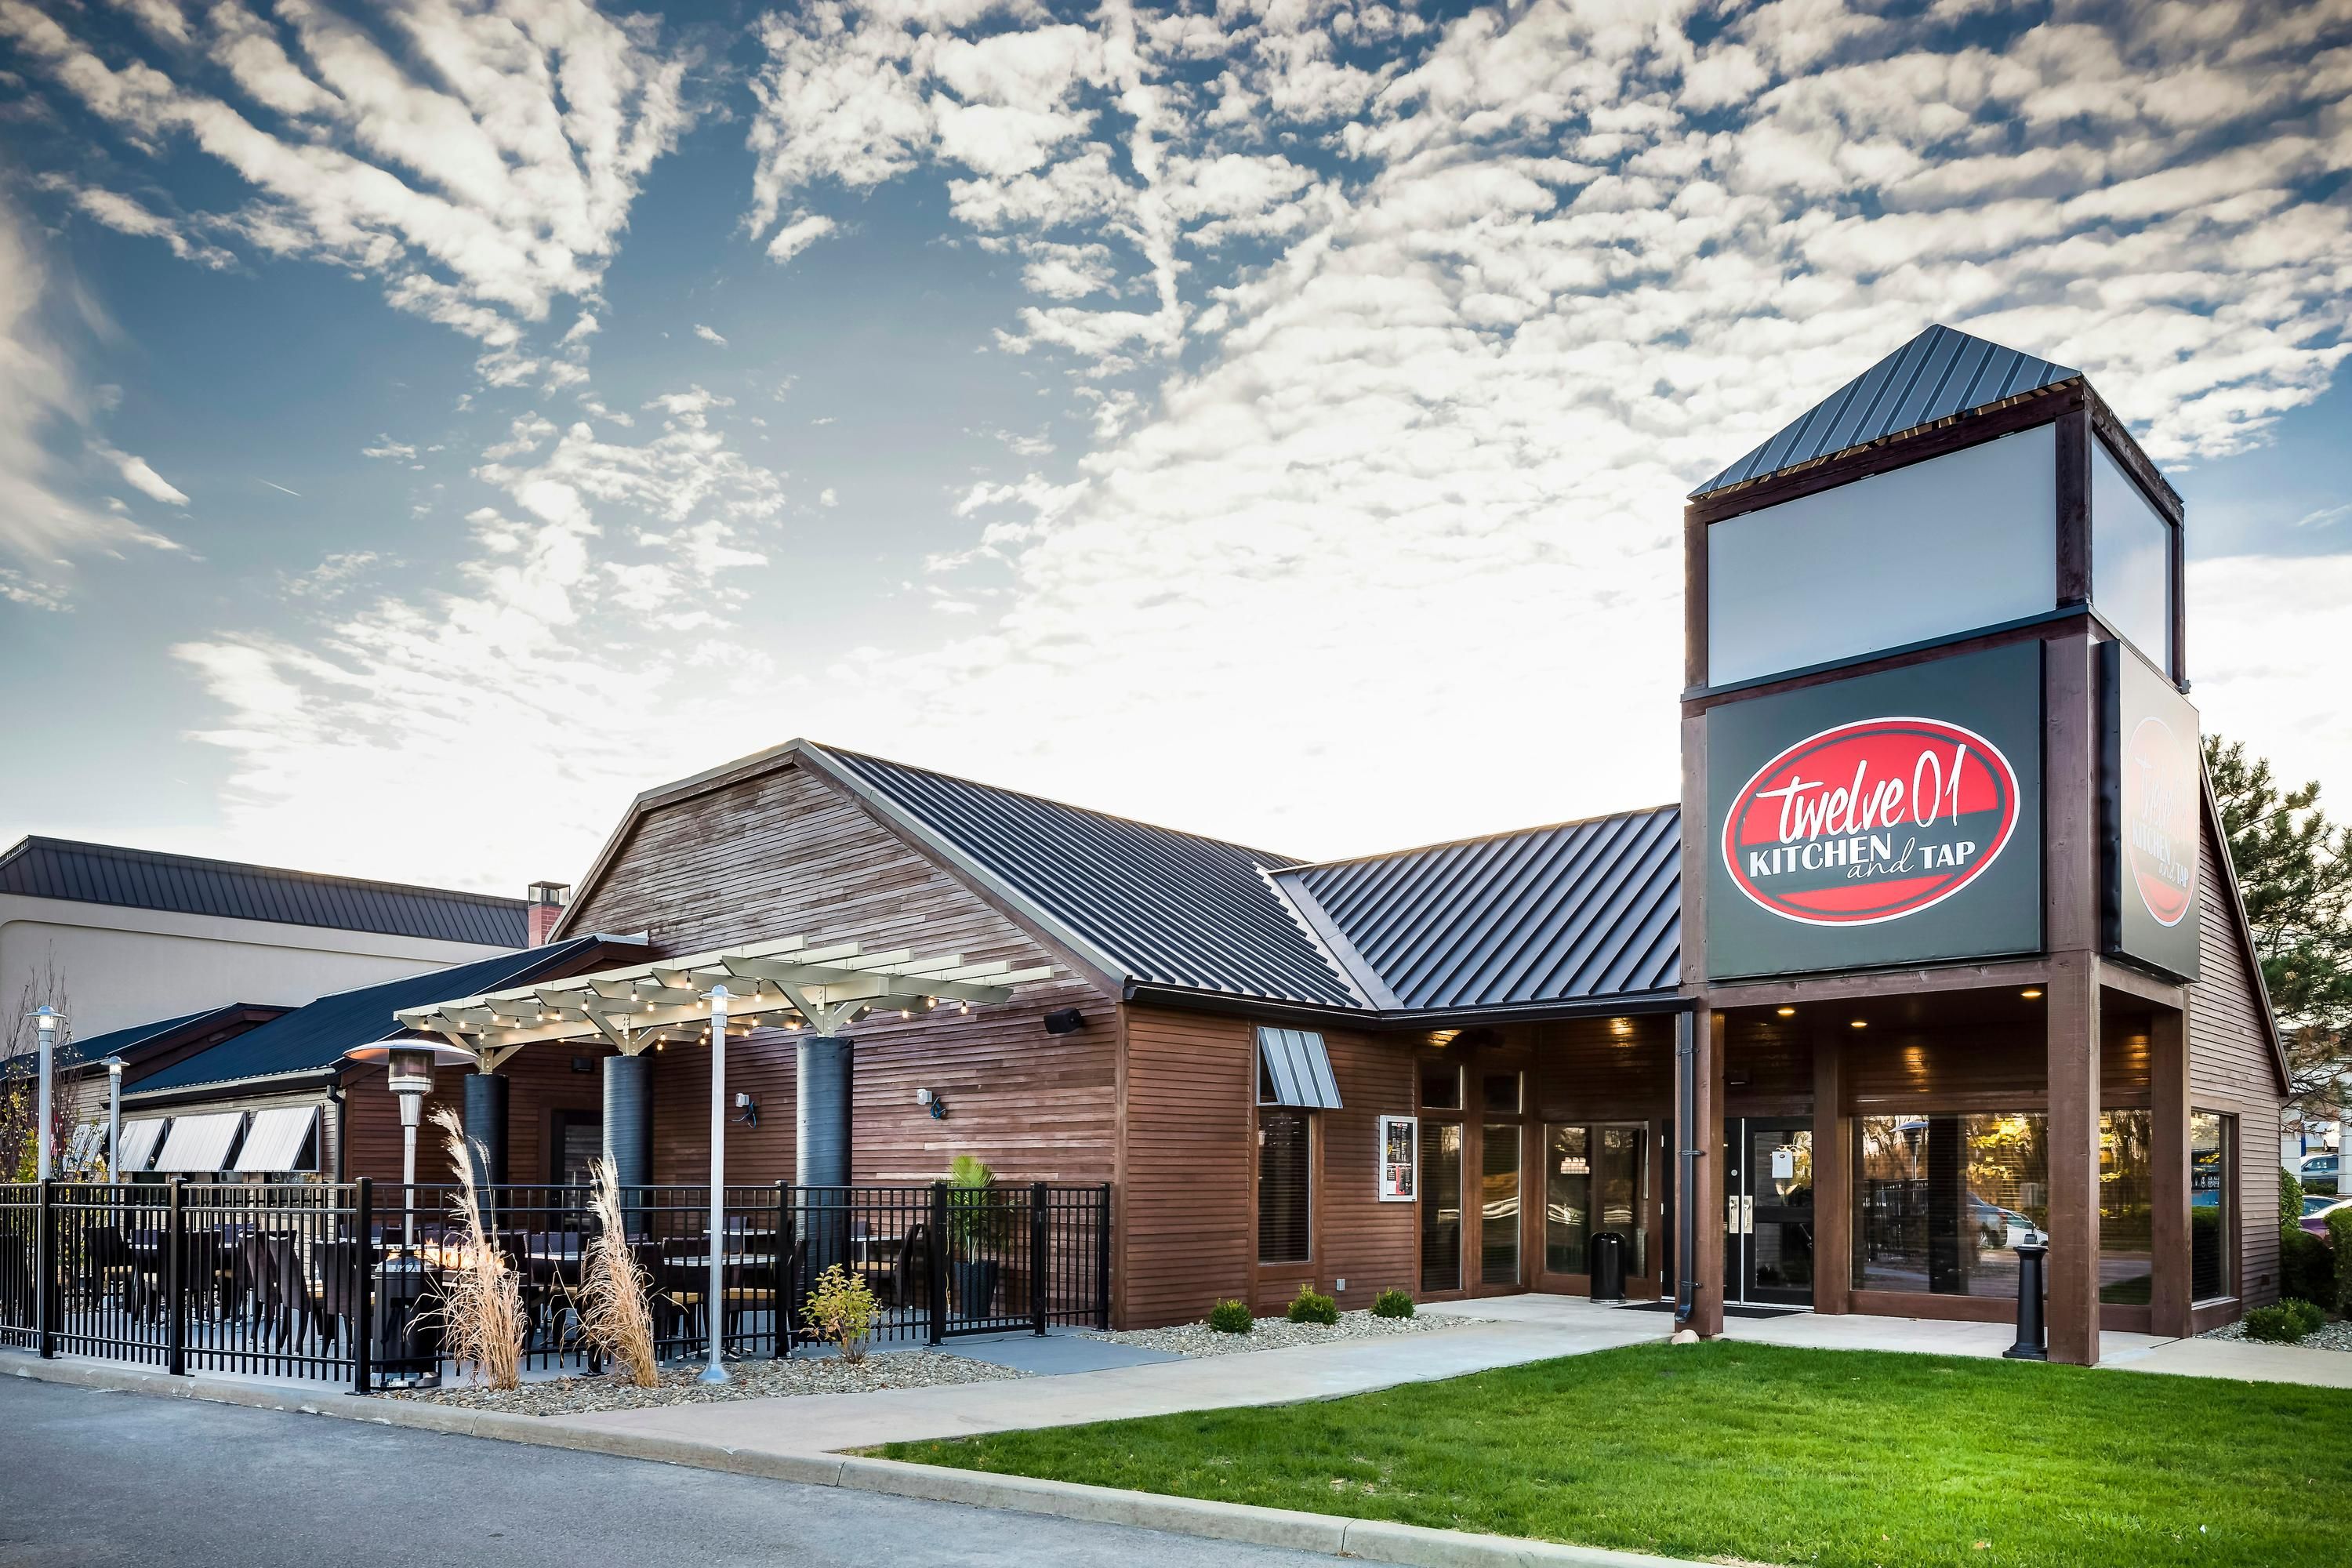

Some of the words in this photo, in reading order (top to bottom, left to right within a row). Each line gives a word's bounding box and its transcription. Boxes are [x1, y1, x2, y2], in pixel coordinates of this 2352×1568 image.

[1911, 742, 1968, 829] 01
[1749, 832, 1892, 879] KITCHEN
[1846, 837, 1916, 880] and
[1918, 840, 1976, 870] TAP
[2132, 816, 2171, 866] KITCHEN
[2175, 862, 2190, 888] TAP
